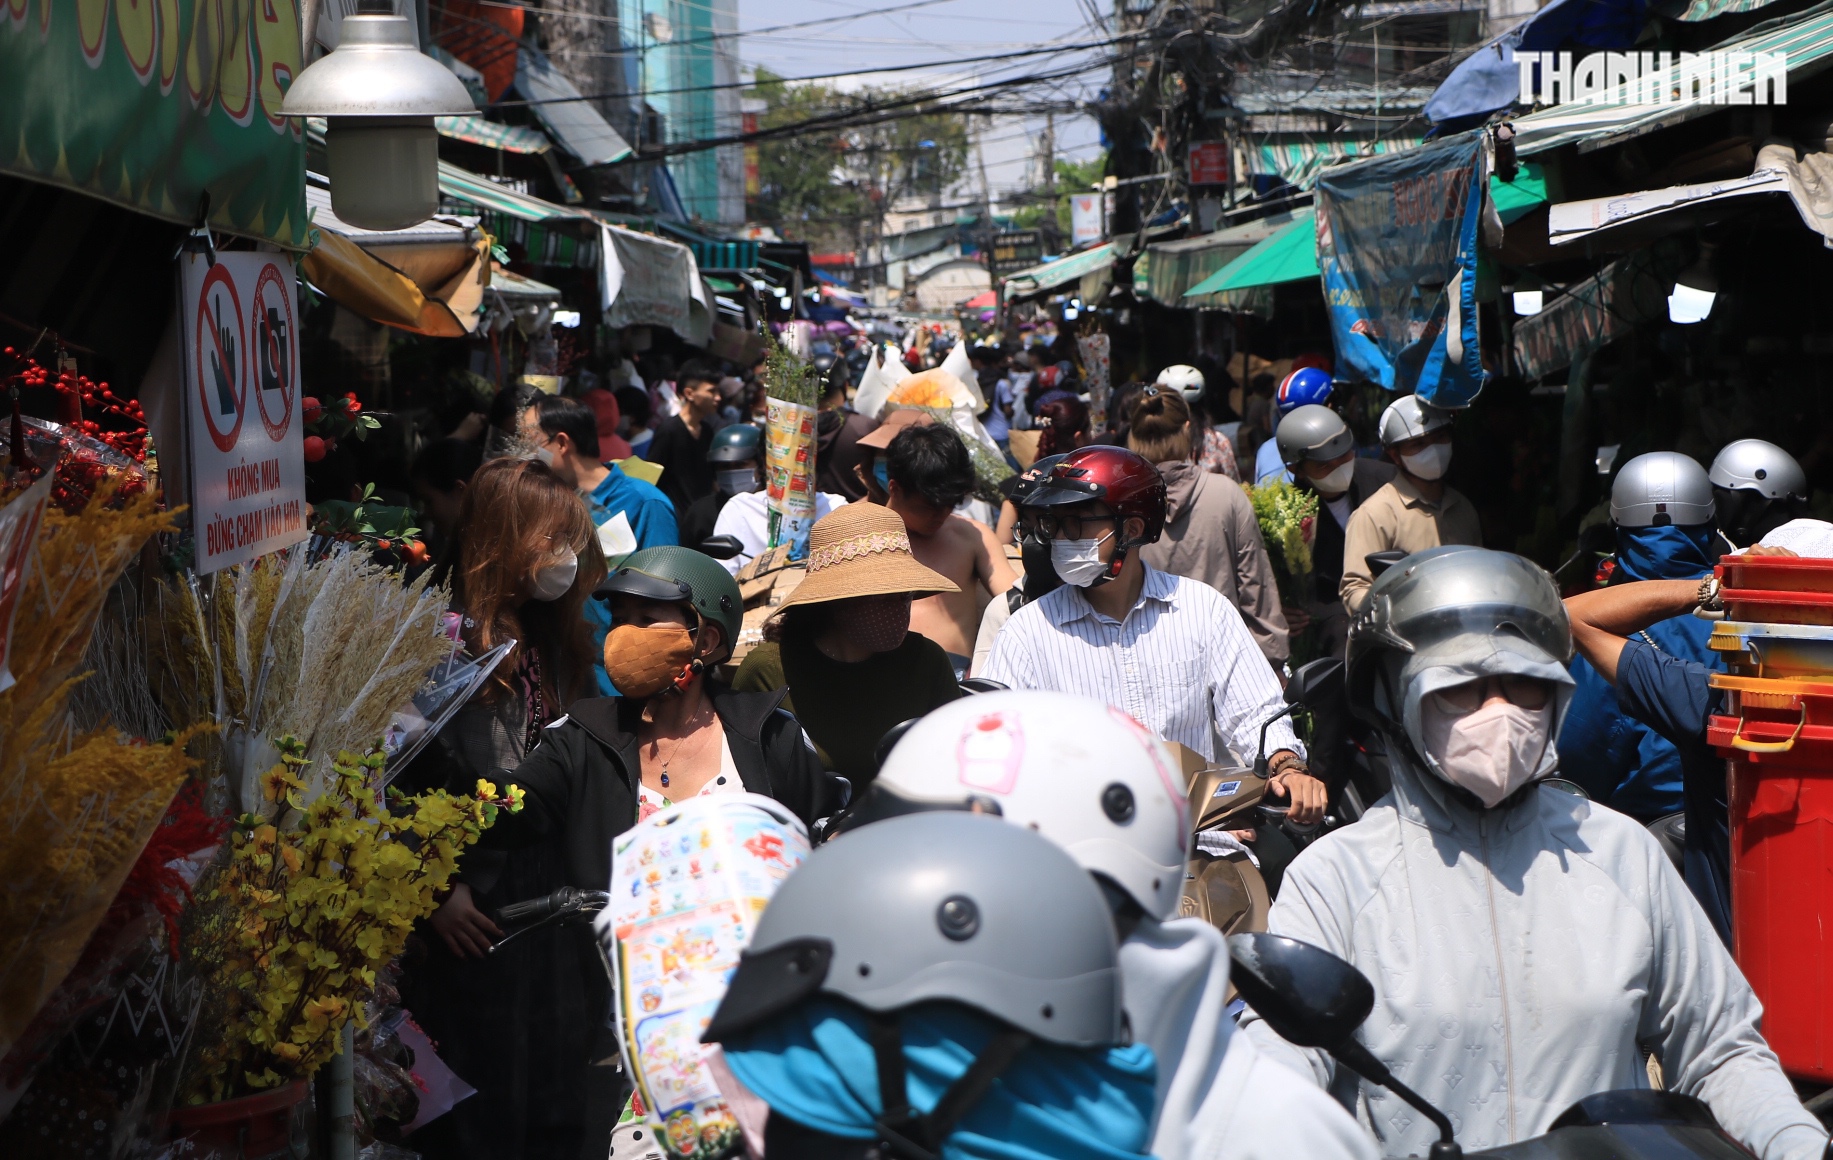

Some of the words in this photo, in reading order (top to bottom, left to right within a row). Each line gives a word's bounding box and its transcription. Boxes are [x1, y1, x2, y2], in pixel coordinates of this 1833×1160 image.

[228, 457, 259, 501] KHÔNG
[261, 458, 280, 492] MUA
[207, 512, 234, 556] ĐỪNG
[237, 510, 263, 550] CHẠM
[264, 497, 282, 538] VÀO
[284, 499, 300, 533] HOA
